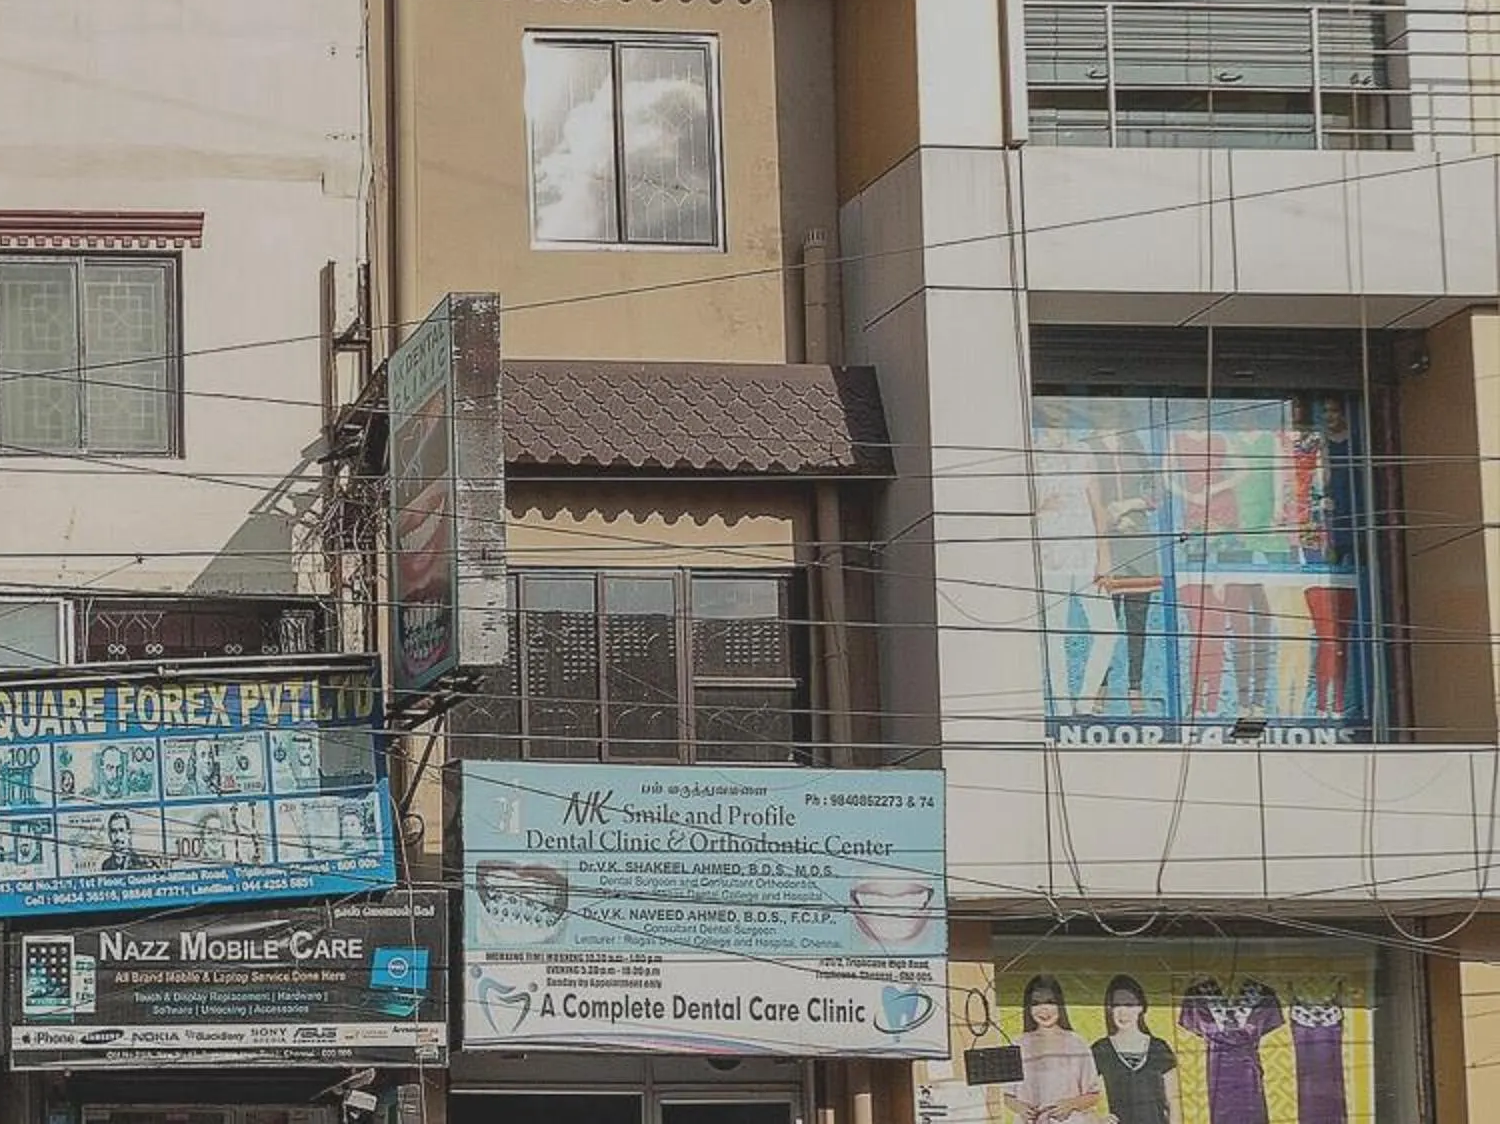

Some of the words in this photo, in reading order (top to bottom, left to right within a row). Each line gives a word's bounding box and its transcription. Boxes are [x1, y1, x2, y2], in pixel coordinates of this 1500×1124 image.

[116, 680, 231, 734] FOREX
[1058, 724, 1164, 746] NOOR
[131, 746, 155, 764] 100
[563, 790, 614, 826] NK
[623, 802, 680, 826] Smile
[685, 804, 723, 826] and
[728, 804, 797, 827] Profile
[919, 795, 935, 808] 74
[175, 837, 204, 858] 100
[526, 829, 594, 852] Dental
[599, 829, 662, 853] Clinic
[667, 828, 685, 851] &
[689, 830, 819, 854] Orthodontic
[824, 835, 895, 857] Center
[625, 861, 688, 875] SHAKEEL
[629, 908, 685, 921] NAVEED
[131, 970, 163, 983] Brand
[250, 970, 291, 982] Service
[540, 993, 556, 1018] A
[562, 993, 665, 1024] Complete
[672, 995, 742, 1022] Dental
[748, 997, 800, 1023] Care
[807, 996, 867, 1024] Clinic
[35, 1031, 75, 1045] iPhone
[131, 1031, 180, 1043] NOKIA
[250, 1027, 287, 1037] SONY
